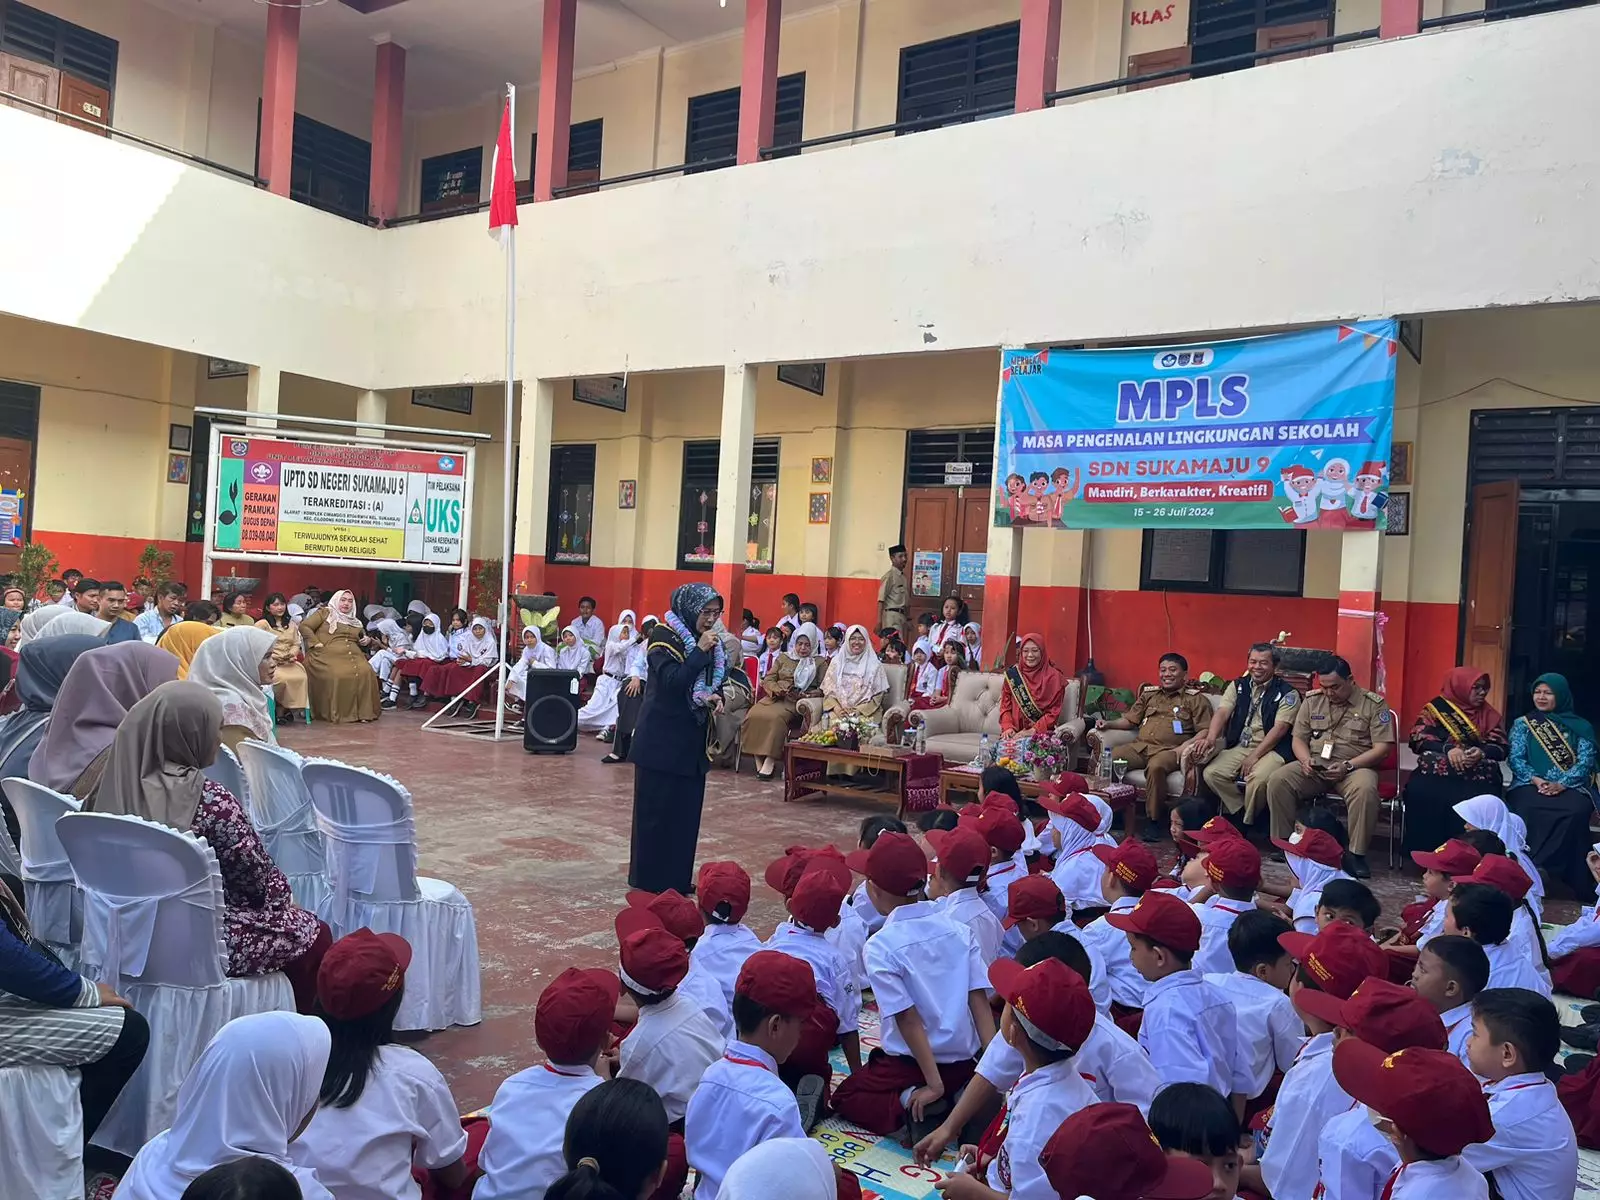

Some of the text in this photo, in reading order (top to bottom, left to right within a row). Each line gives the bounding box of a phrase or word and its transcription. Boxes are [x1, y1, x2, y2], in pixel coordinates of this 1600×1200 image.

[1131, 4, 1175, 26] KLAS
[1011, 364, 1042, 375] BELAJAR
[1116, 374, 1250, 422] MPLS
[1022, 423, 1359, 448] MASA PENGENALAN LINGKUNGAN SEKOLAH
[1088, 456, 1270, 477] SDN SUKAMAJU 9
[284, 469, 404, 495] UPTD SD NEGERI SUKAMAJU 9
[436, 481, 460, 492] PELAKSANA
[245, 492, 276, 502] GERAKAN
[1088, 484, 1268, 500] Mandiri, Berkarakter, Kreatif!
[244, 504, 275, 515] PRAMUKA
[303, 497, 366, 510] TERAKREDITASI
[372, 501, 384, 512] (A)
[427, 498, 460, 534] UKS
[1134, 508, 1144, 516] 15
[1153, 508, 1165, 516] 26
[1167, 507, 1186, 516] Juli
[1188, 508, 1214, 516] 2024
[243, 517, 275, 527] GUGUS DEPAN
[294, 532, 339, 541] TERWUJUDNYA
[305, 544, 334, 552] BERMUTU
